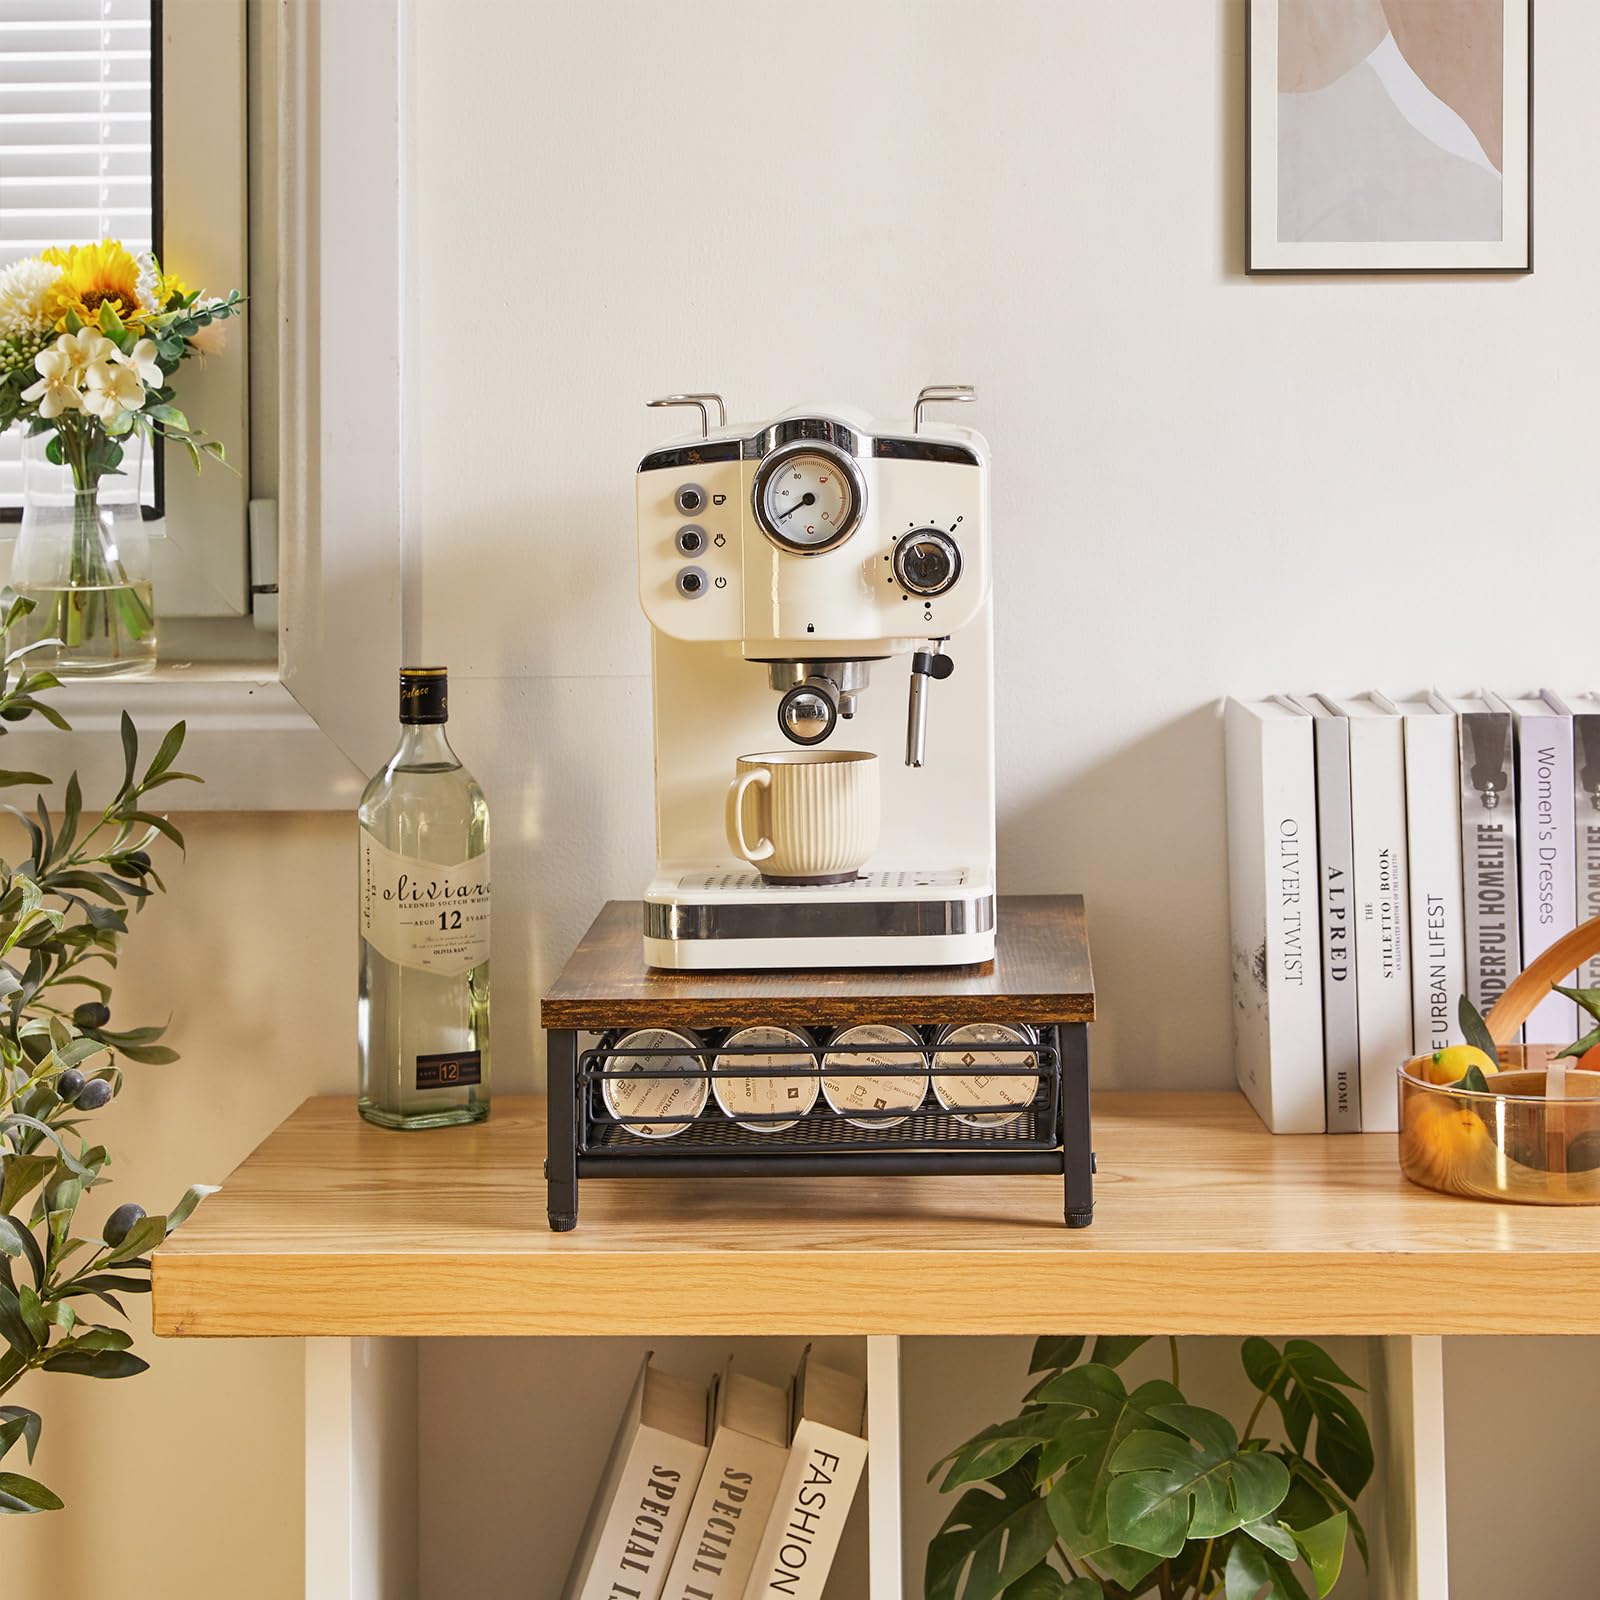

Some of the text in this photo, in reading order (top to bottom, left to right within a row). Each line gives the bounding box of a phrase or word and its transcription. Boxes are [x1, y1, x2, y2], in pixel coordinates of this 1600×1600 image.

[1477, 824, 1505, 915] HOMELIFE
[1537, 747, 1557, 925] Women's Dresses
[438, 910, 463, 931] 12
[1280, 818, 1303, 986] OLIVER TWIST
[1328, 866, 1347, 982] ALPRED
[1365, 903, 1373, 921] THE
[1379, 848, 1393, 979] STILETTO BOOK
[1427, 893, 1446, 958] LIFEST
[1430, 965, 1449, 1033] URBAN
[440, 1064, 457, 1080] 12
[1337, 1071, 1348, 1114] HOME
[619, 1464, 681, 1575] SPECIAL
[692, 1466, 753, 1577] SPECIAL
[769, 1448, 840, 1596] FASHION
